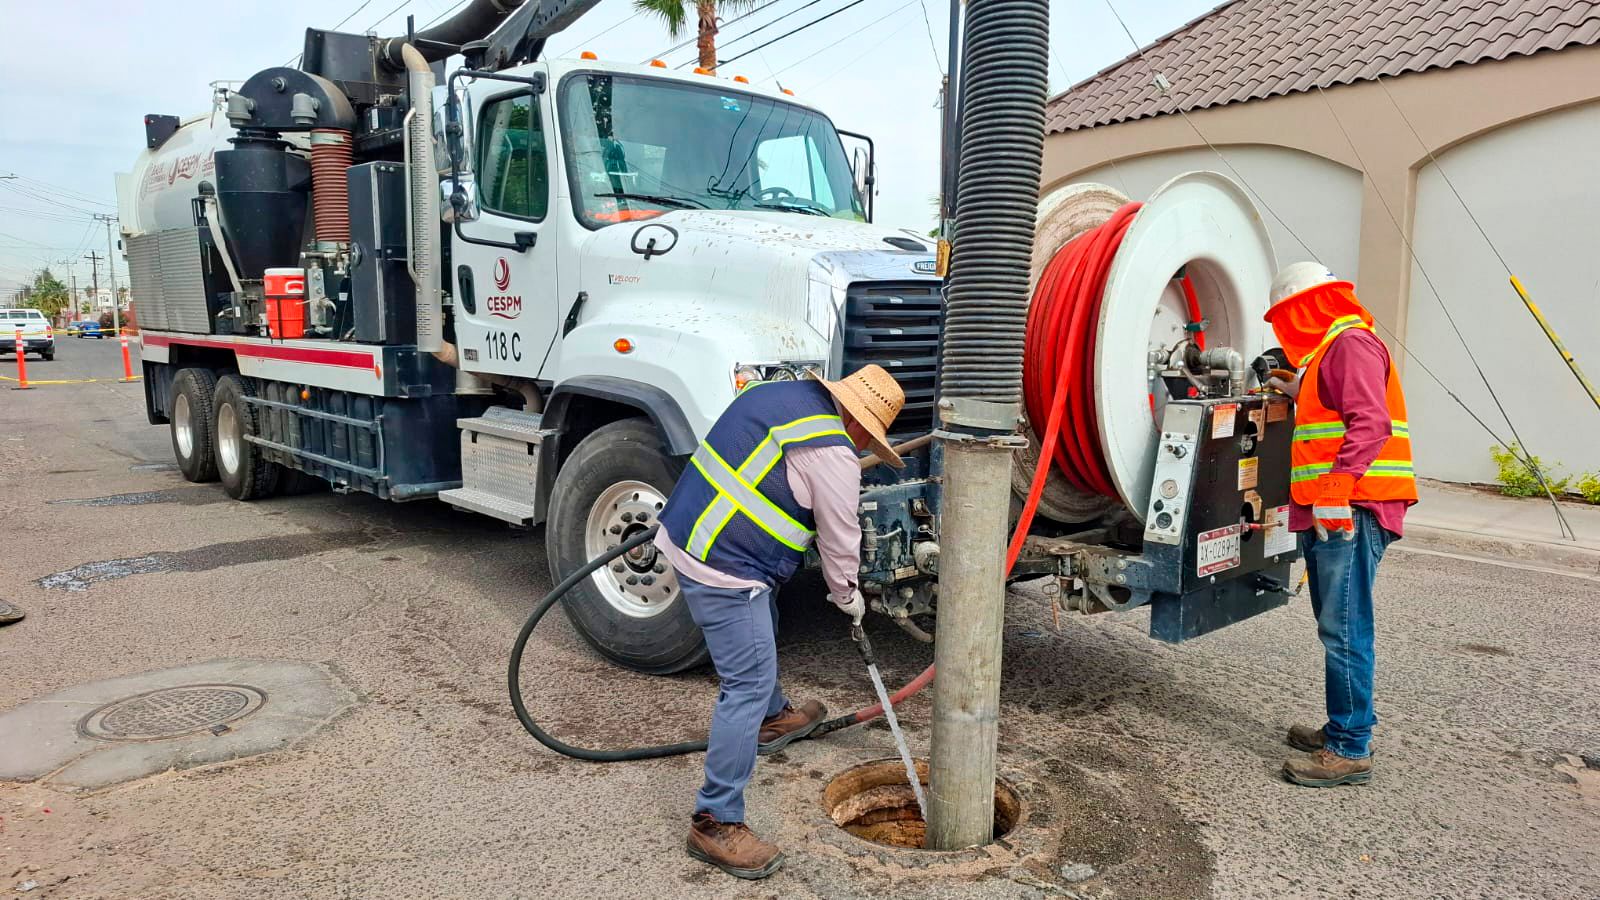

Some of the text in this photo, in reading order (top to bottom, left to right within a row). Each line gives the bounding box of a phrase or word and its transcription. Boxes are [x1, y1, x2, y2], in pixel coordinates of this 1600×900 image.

[487, 296, 522, 311] CESPM
[486, 331, 521, 362] 118 C
